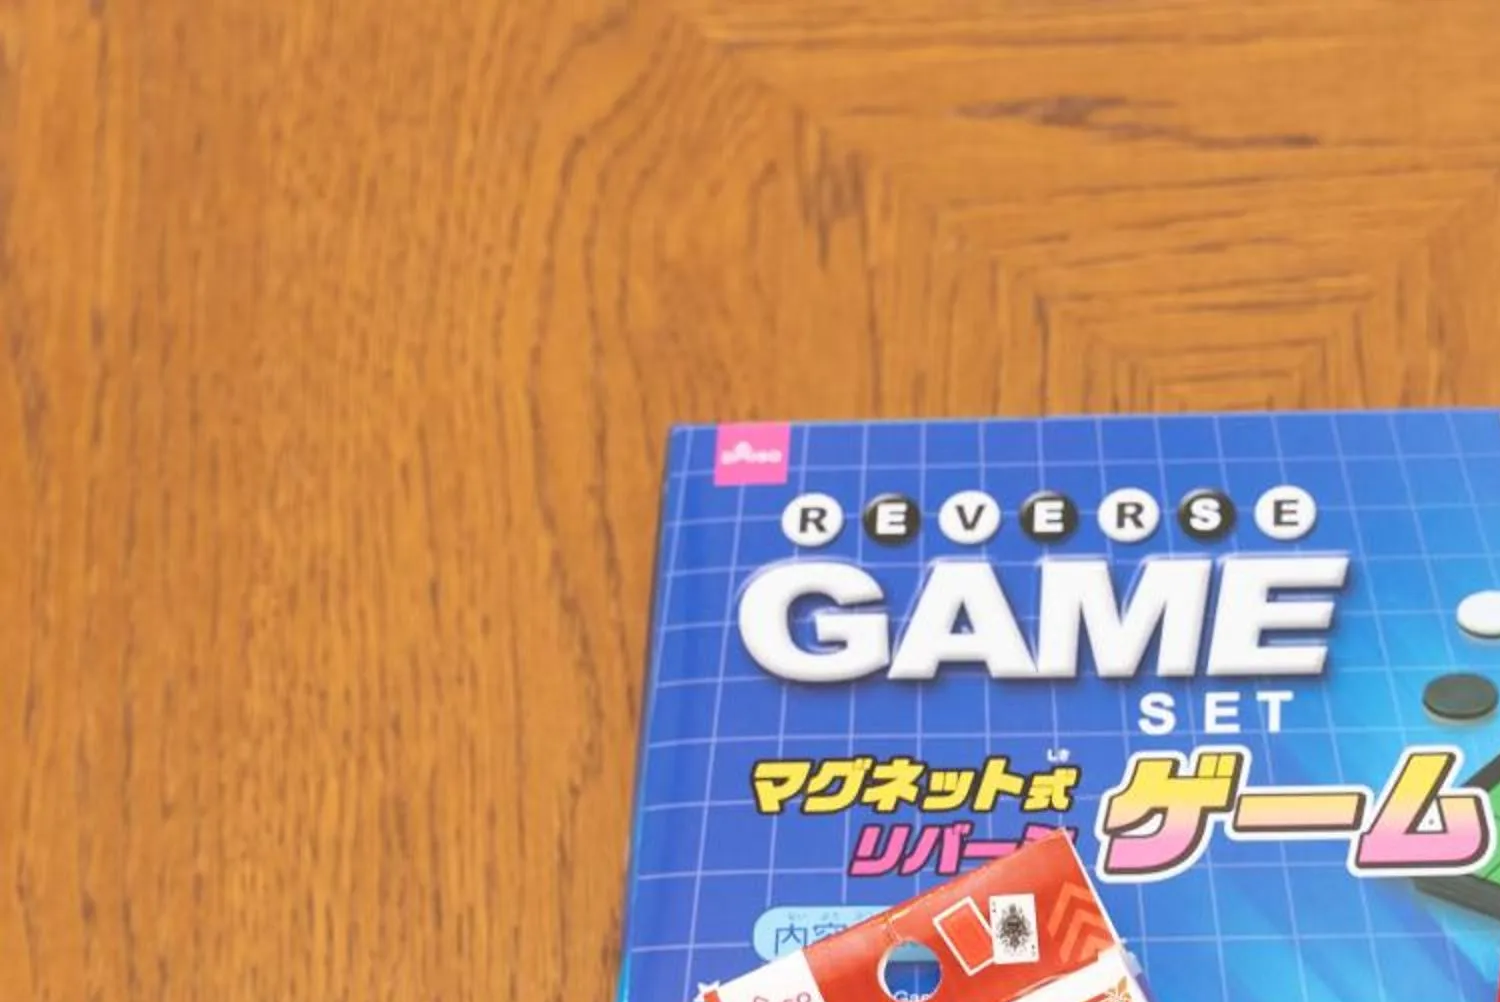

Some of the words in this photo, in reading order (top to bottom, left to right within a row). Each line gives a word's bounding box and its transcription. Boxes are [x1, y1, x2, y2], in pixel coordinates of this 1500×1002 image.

[793, 494, 1305, 538] REVERSE
[737, 554, 1349, 682] GAME
[1138, 691, 1294, 735] SET
[753, 756, 1079, 814] マグネット式
[1100, 749, 1493, 878] ゲーム
